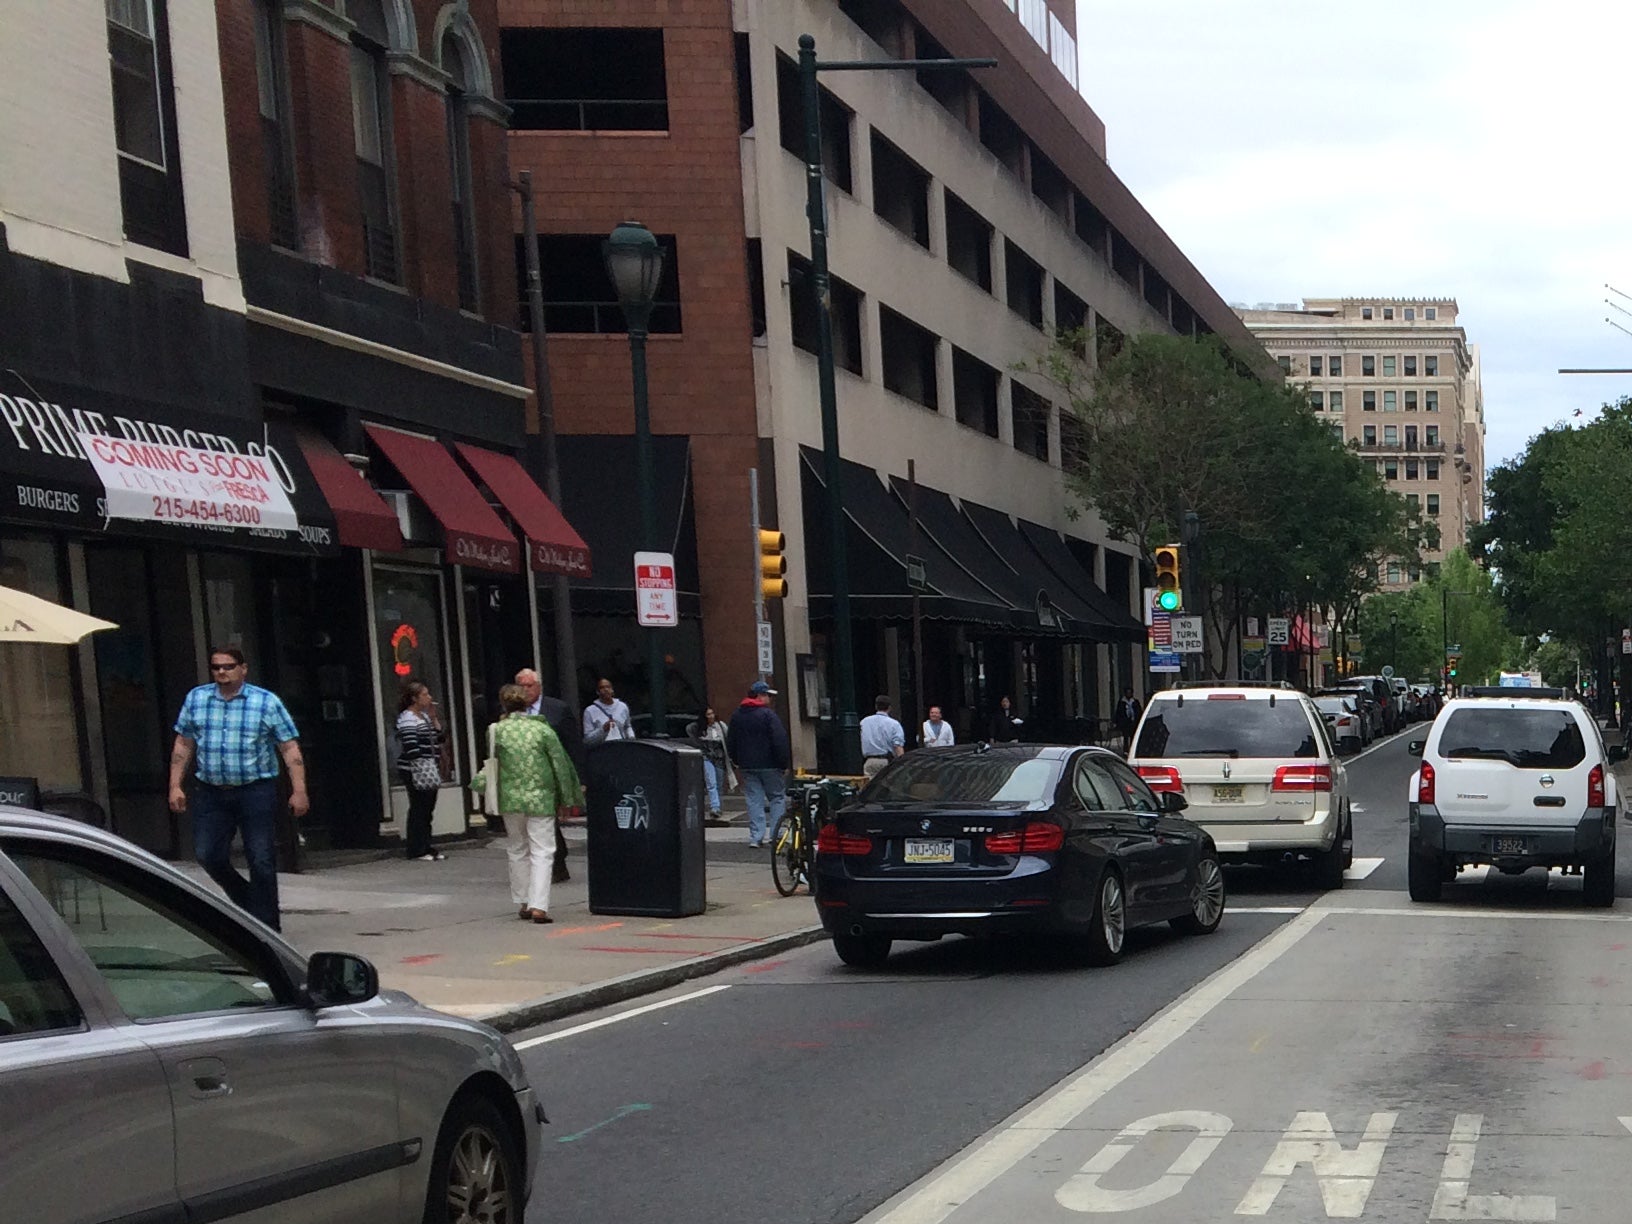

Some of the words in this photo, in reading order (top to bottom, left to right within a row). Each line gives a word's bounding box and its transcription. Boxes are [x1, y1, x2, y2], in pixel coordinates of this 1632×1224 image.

[92, 438, 199, 473] COMING
[198, 453, 270, 482] SOON
[223, 479, 270, 504] FRESCA
[17, 485, 80, 513] BURGERS
[299, 525, 331, 545] SOUPS
[153, 496, 261, 525] 215-454-6300
[648, 567, 662, 577] NO
[1176, 631, 1198, 639] TURN
[1270, 631, 1287, 643] 25
[1172, 641, 1184, 649] ON
[1186, 641, 1202, 649] RED
